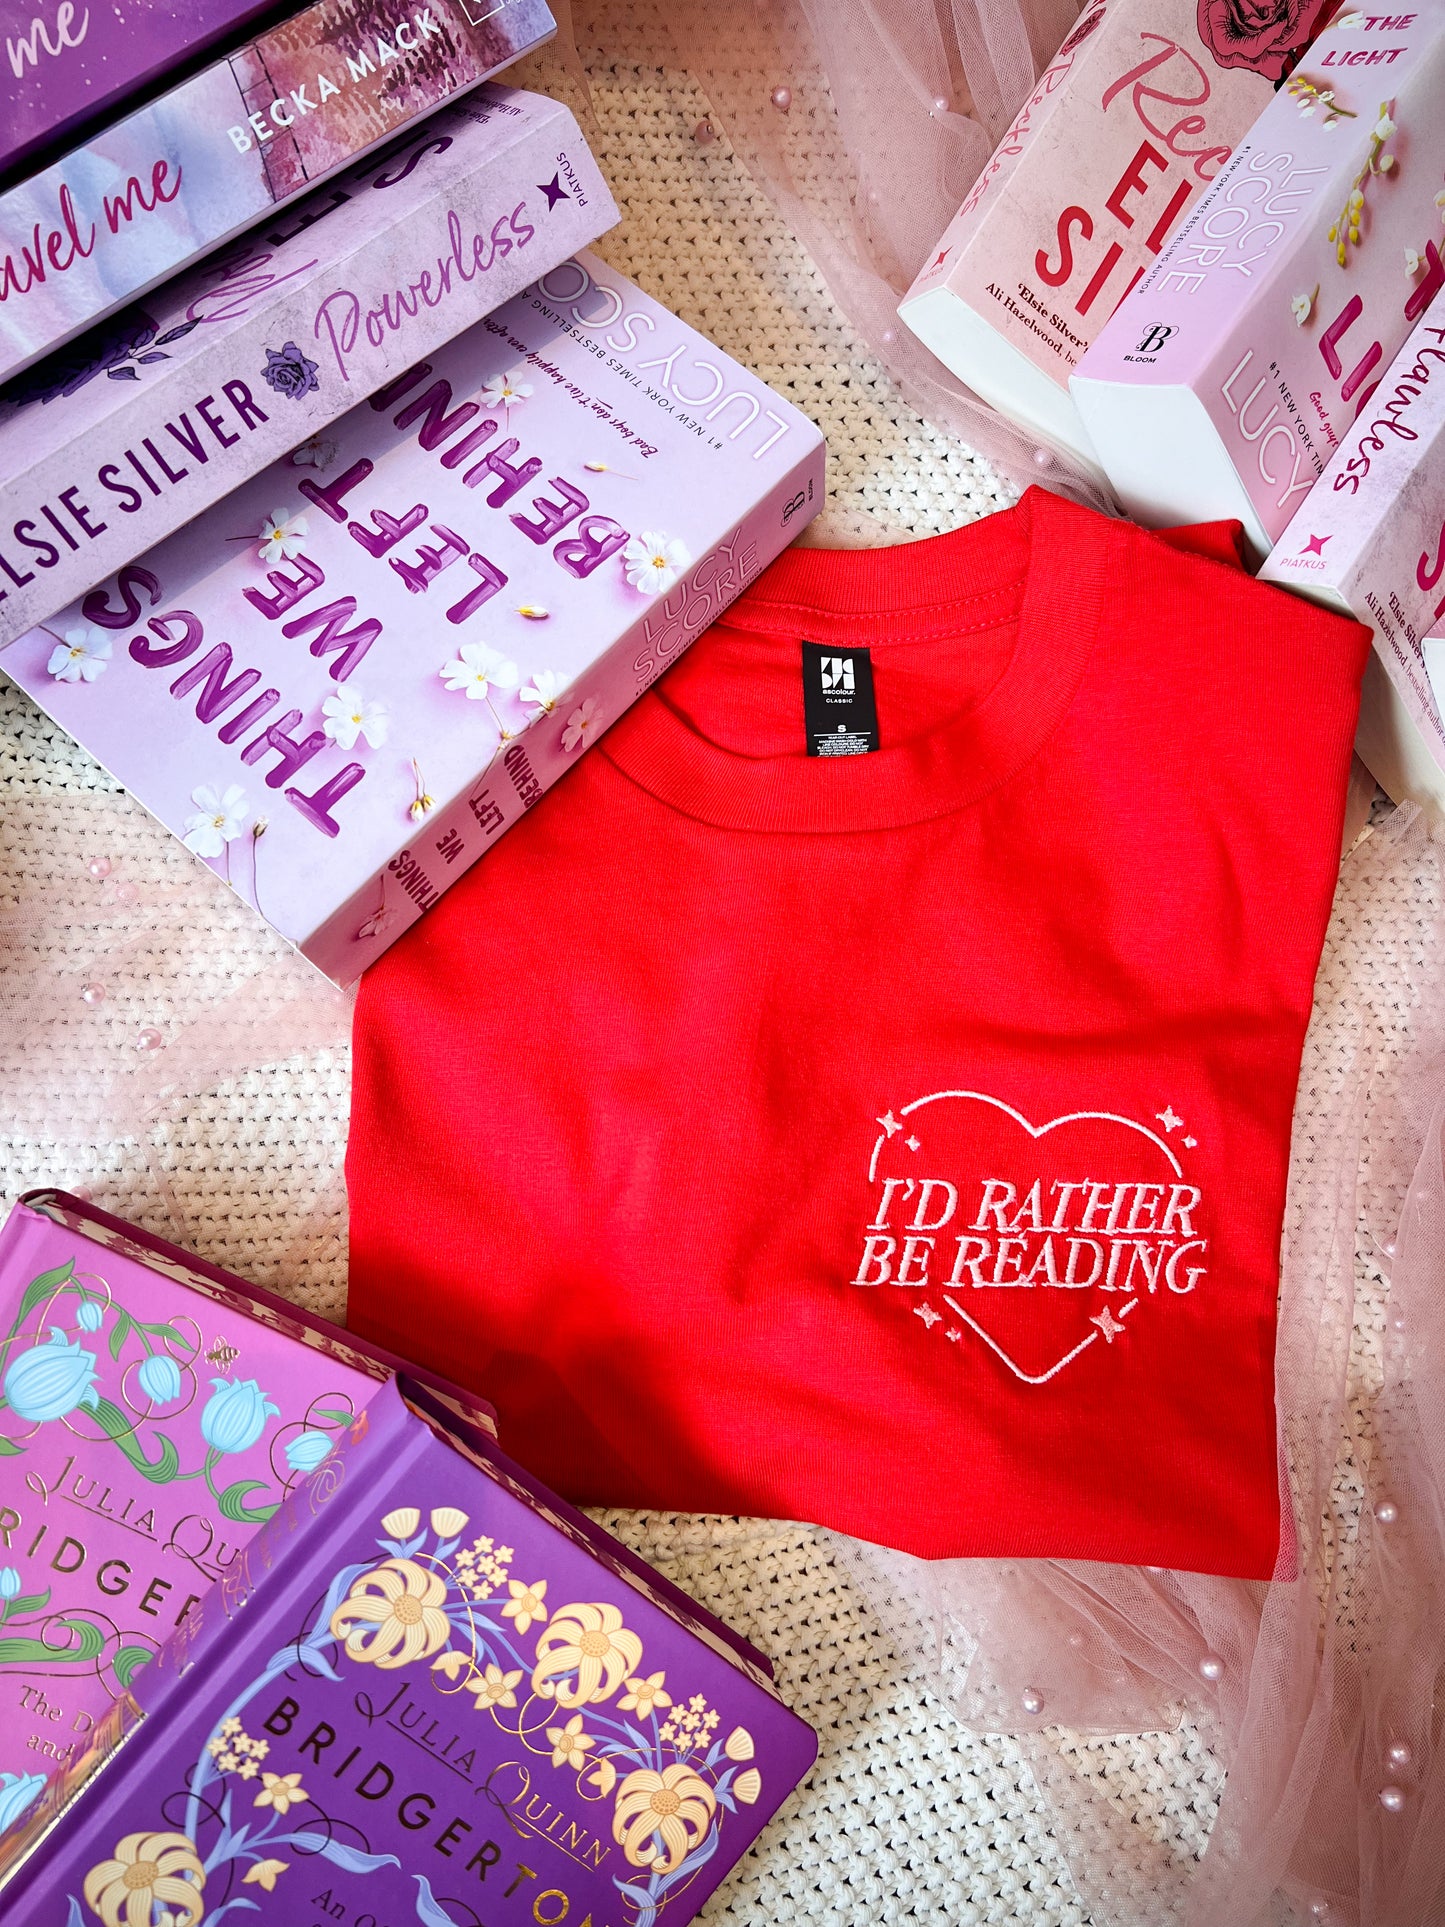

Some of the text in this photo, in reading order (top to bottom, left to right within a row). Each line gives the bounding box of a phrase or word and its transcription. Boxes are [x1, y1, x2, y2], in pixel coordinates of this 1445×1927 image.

[6, 1, 89, 78] me
[1364, 13, 1419, 32] THE
[227, 8, 441, 154] BECKA MACK
[1321, 47, 1409, 67] LIGHT
[961, 52, 1075, 217] Reckless
[1229, 155, 1244, 172] NEW
[103, 160, 182, 233] me
[556, 152, 588, 207] PIATKUS
[1197, 193, 1217, 214] TIMES
[1217, 173, 1230, 192] YORK
[1156, 151, 1295, 296] SCORE
[1161, 215, 1200, 262] BESTSELLING
[1222, 165, 1330, 278] LUCY
[314, 201, 535, 382] Powerless
[1138, 264, 1163, 294] AUTHOR
[507, 332, 528, 353] ever
[985, 283, 1004, 301] Ali
[1003, 296, 1063, 357] Hazelwood,
[1049, 314, 1089, 354] Silver’
[525, 350, 566, 384] happily
[531, 301, 723, 450] #1 NEW YORK TIMES BESTSELLING
[1123, 354, 1157, 364] BLOOM
[565, 380, 585, 400] live
[638, 344, 790, 460] LUCY
[1269, 361, 1280, 379] #1
[1278, 382, 1297, 414] NEW
[1294, 415, 1315, 450] YORK
[608, 416, 636, 440] boys
[633, 436, 658, 458] Bad
[1222, 350, 1314, 508] LUCY
[1309, 391, 1339, 448] Good guys
[0, 379, 269, 603] LSIE SILVER
[298, 458, 508, 624] LEFT
[1280, 558, 1327, 570] PIATKUS
[633, 541, 757, 683] SCORE
[644, 527, 741, 643] LUCY
[242, 553, 383, 683] WE
[1364, 591, 1379, 608] Ali
[1406, 664, 1430, 712] bestselling
[1427, 706, 1444, 738] author
[81, 565, 366, 838] THINGS
[837, 724, 846, 733] S
[504, 745, 543, 808] BEHIND
[469, 789, 505, 835] LEFT
[436, 829, 464, 865] WE
[388, 850, 439, 914] THINGS
[967, 1178, 1202, 1238] RATHER
[849, 1235, 1208, 1295] BE READING
[19, 1685, 63, 1722] The
[26, 1734, 75, 1761] and
[310, 1888, 347, 1921] An
